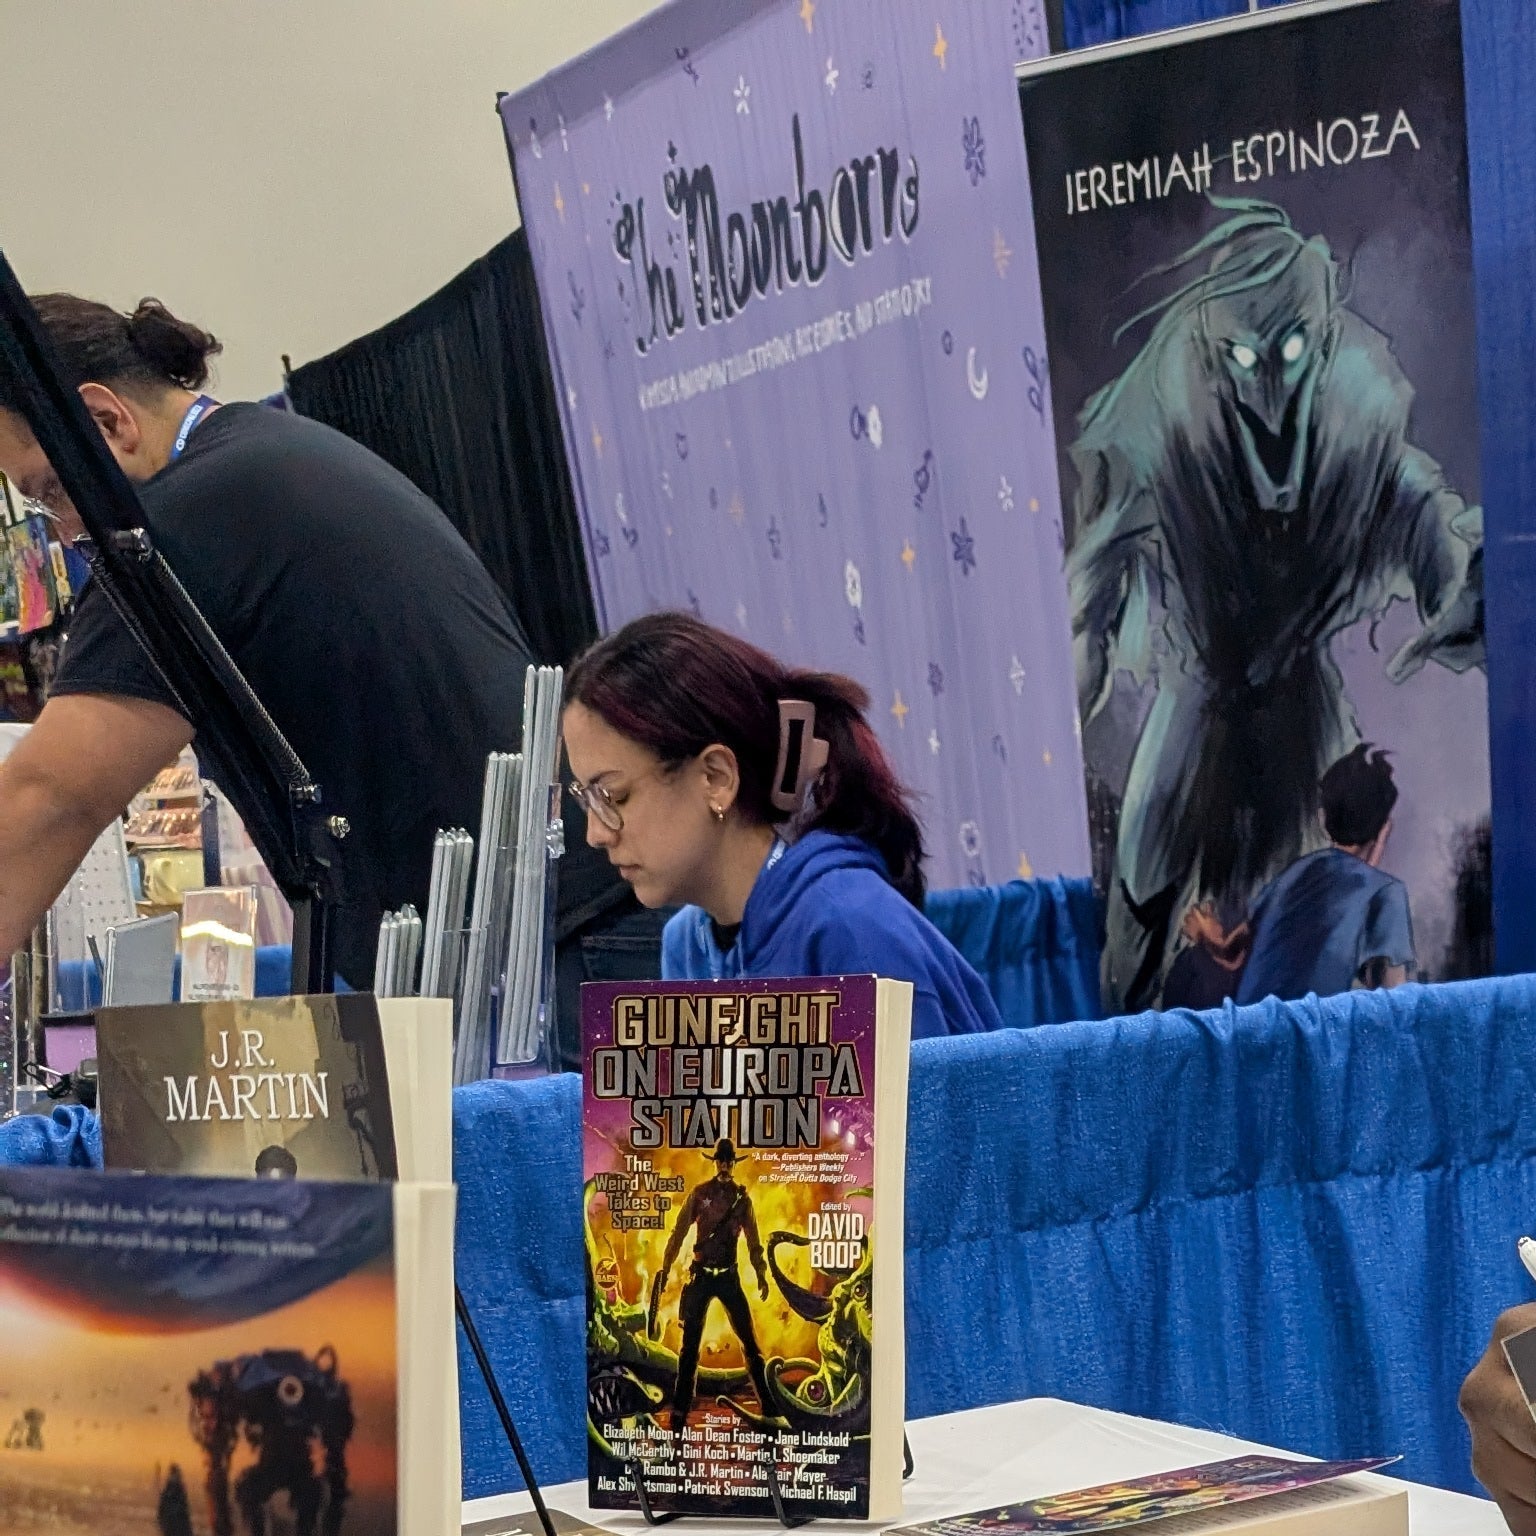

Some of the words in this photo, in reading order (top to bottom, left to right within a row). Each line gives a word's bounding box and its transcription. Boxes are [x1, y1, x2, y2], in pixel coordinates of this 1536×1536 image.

[1066, 142, 1212, 215] JEREMIAH
[1231, 109, 1421, 184] ESPINOZA
[615, 993, 840, 1048] GUNFIGHT
[210, 1029, 276, 1068] J.R.
[594, 1047, 657, 1098] ON
[678, 1045, 862, 1098] EUROPA
[163, 1072, 330, 1122] MARTIN
[632, 1099, 820, 1148] STATION
[624, 1155, 651, 1172] The
[782, 1153, 812, 1163] diverting
[814, 1153, 849, 1163] anthology
[819, 1164, 845, 1174] Weekly
[595, 1174, 639, 1191] Weird
[643, 1174, 684, 1191] West
[769, 1173, 798, 1184] Straight
[819, 1174, 842, 1184] Dodge
[843, 1174, 858, 1184] City
[607, 1193, 649, 1210] Takes
[654, 1195, 672, 1210] to
[820, 1202, 842, 1211] Edited
[843, 1202, 852, 1212] by
[612, 1212, 665, 1230] Space!
[808, 1213, 864, 1240] DAVID
[810, 1241, 861, 1269] BOOP
[705, 1413, 731, 1425] Stories
[732, 1414, 741, 1426] by
[603, 1424, 646, 1440] Elizabeth
[647, 1426, 674, 1440] Moon
[681, 1427, 702, 1442] Alan
[705, 1428, 730, 1443] Dean
[733, 1429, 767, 1444] Foster
[774, 1430, 800, 1446] Jane
[802, 1431, 849, 1447] Lindskold
[611, 1441, 626, 1457] Wil
[628, 1442, 675, 1461] McCarthy
[683, 1443, 702, 1459] Gini
[704, 1444, 729, 1460] Koch
[737, 1446, 770, 1462] Martin
[782, 1448, 840, 1465] Shoemaker
[643, 1460, 677, 1476] Rambo
[678, 1461, 686, 1476] &
[688, 1462, 708, 1477] J.R.
[710, 1463, 743, 1479] Martin
[751, 1464, 792, 1482] Alaair
[794, 1467, 826, 1484] Mayer
[597, 1477, 617, 1491] Alex
[618, 1479, 677, 1494] Shvtsman
[684, 1479, 721, 1495] Patrick
[723, 1483, 769, 1497] Swenson
[778, 1484, 815, 1500] Michael
[826, 1486, 857, 1503] Haspil
